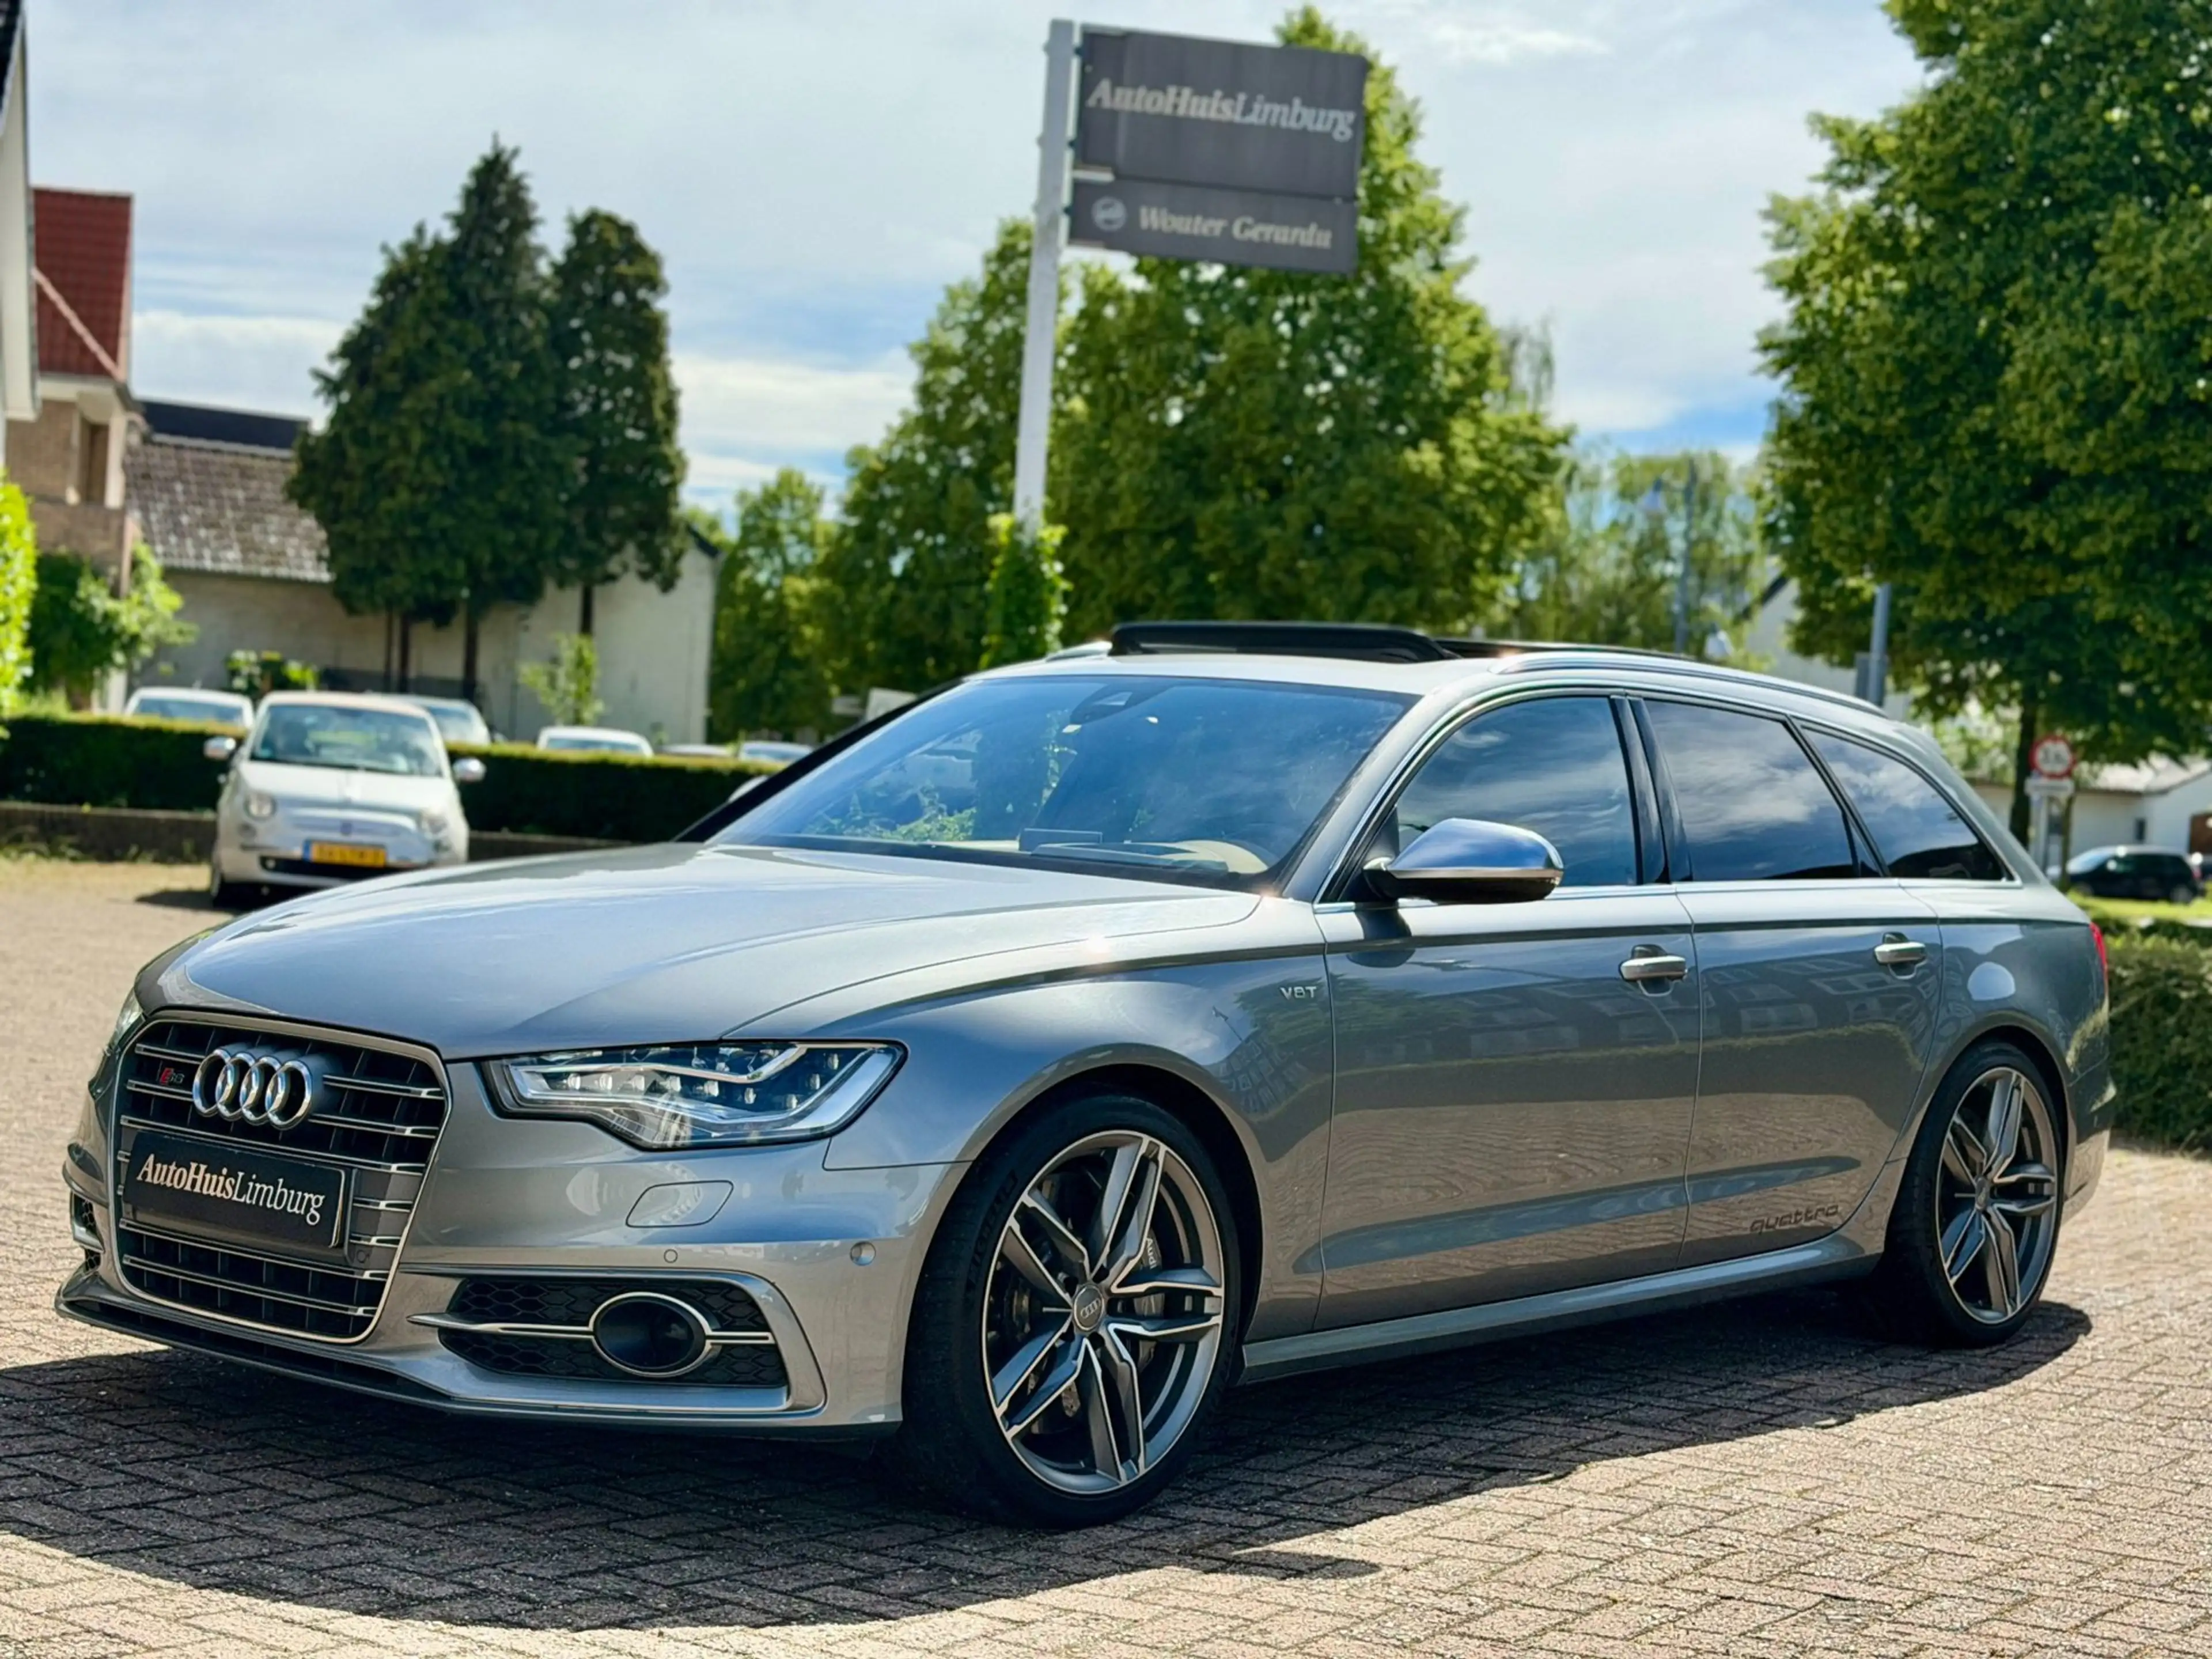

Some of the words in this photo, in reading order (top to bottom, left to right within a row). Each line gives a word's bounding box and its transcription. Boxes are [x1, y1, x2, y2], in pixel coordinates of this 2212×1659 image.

[1086, 78, 1355, 142] AutoHuisLimburg
[1139, 206, 1228, 237] Wouter
[1280, 986, 1317, 1000] V8T
[136, 1154, 325, 1226] AutoHuisLimburg
[1750, 1205, 1839, 1235] quattro
[1144, 1237, 1157, 1270] Audi
